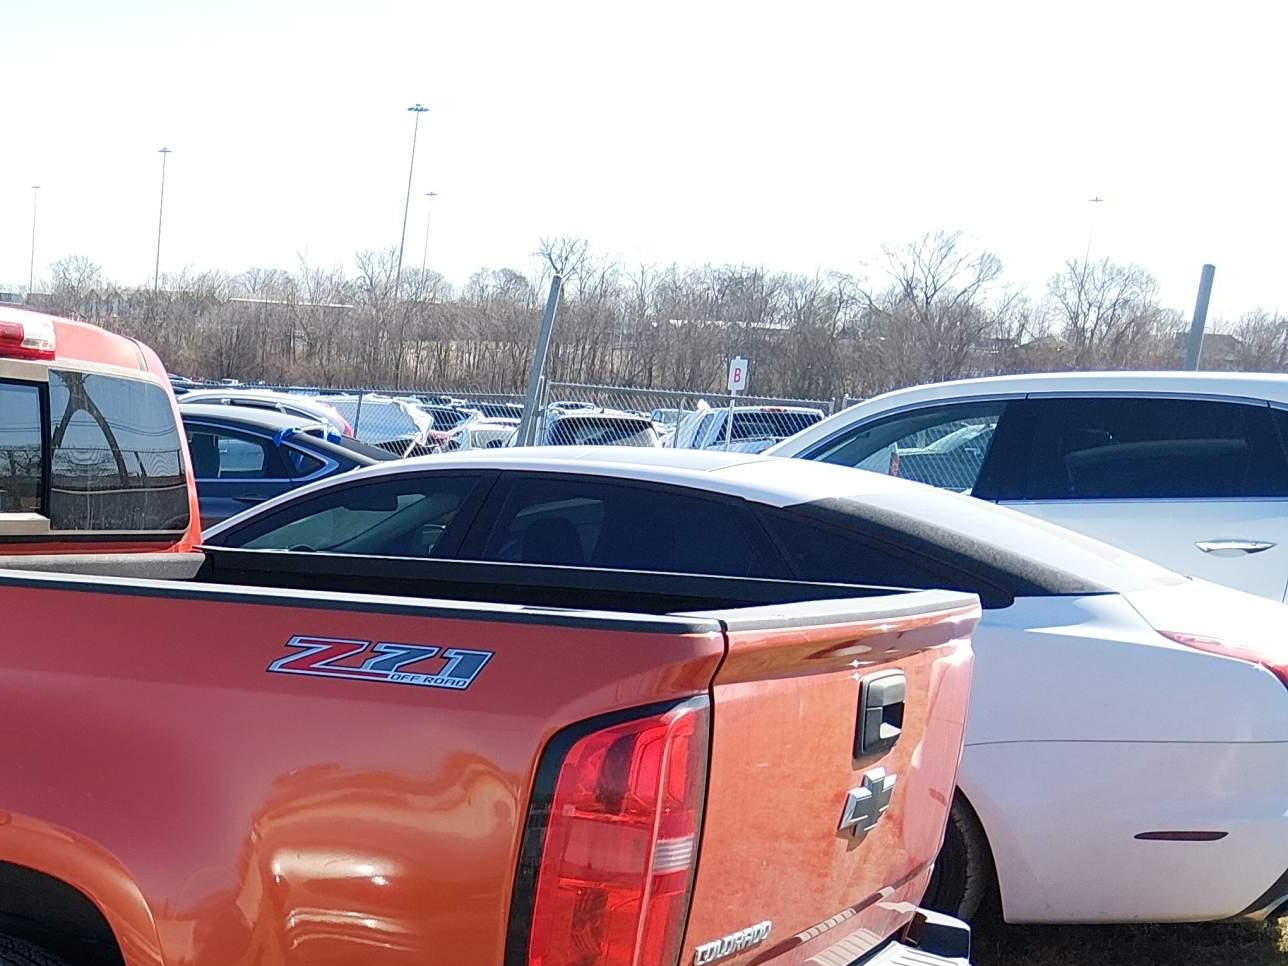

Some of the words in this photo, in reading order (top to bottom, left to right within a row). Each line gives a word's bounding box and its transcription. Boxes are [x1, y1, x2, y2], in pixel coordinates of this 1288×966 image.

[733, 367, 742, 384] B
[265, 634, 496, 684] Z71
[390, 673, 421, 683] OFF
[423, 676, 467, 688] ROAD
